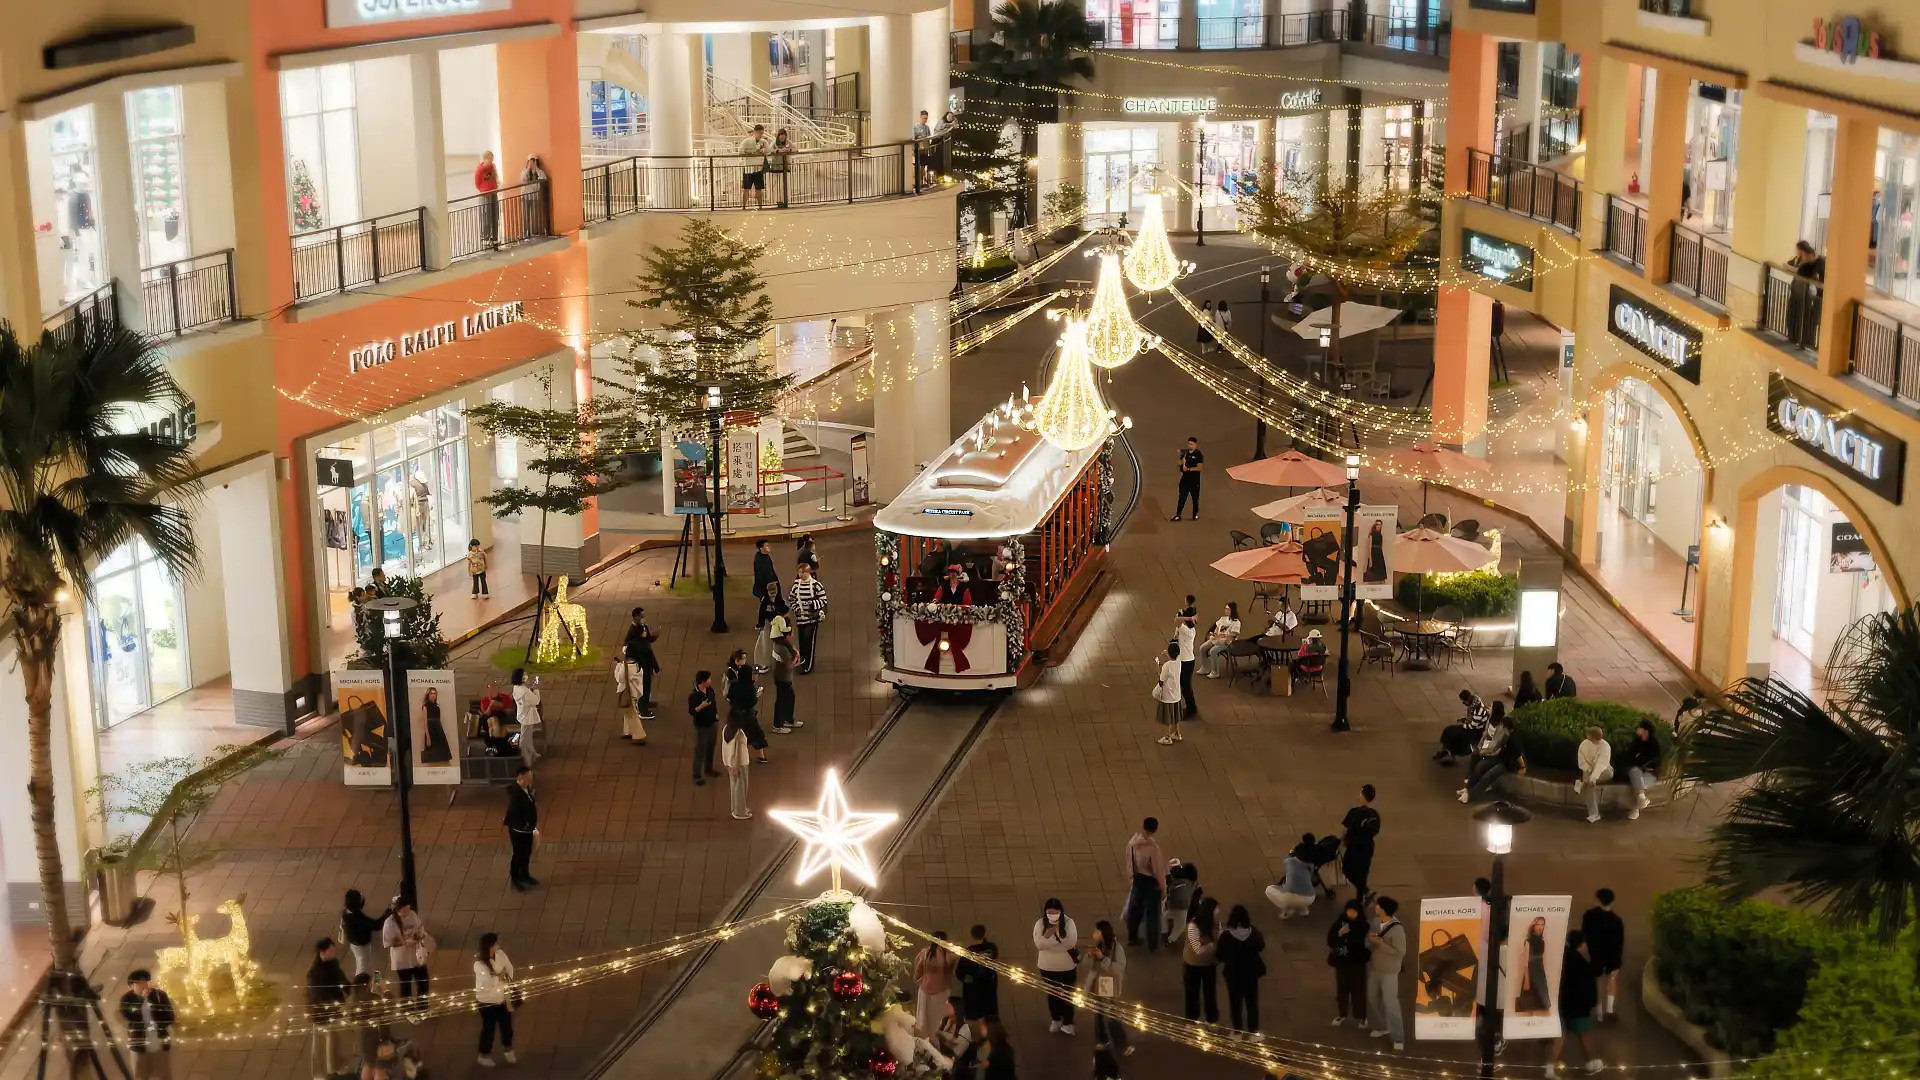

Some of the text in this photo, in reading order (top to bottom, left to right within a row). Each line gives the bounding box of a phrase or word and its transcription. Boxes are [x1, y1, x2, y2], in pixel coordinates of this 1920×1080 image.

[1124, 98, 1217, 112] CHANTELLE
[351, 301, 525, 373] POLO RALPH LAUREN
[1614, 302, 1688, 366] COACH
[1778, 397, 1883, 480] COACH
[1425, 907, 1476, 916] MICHAEL KORS
